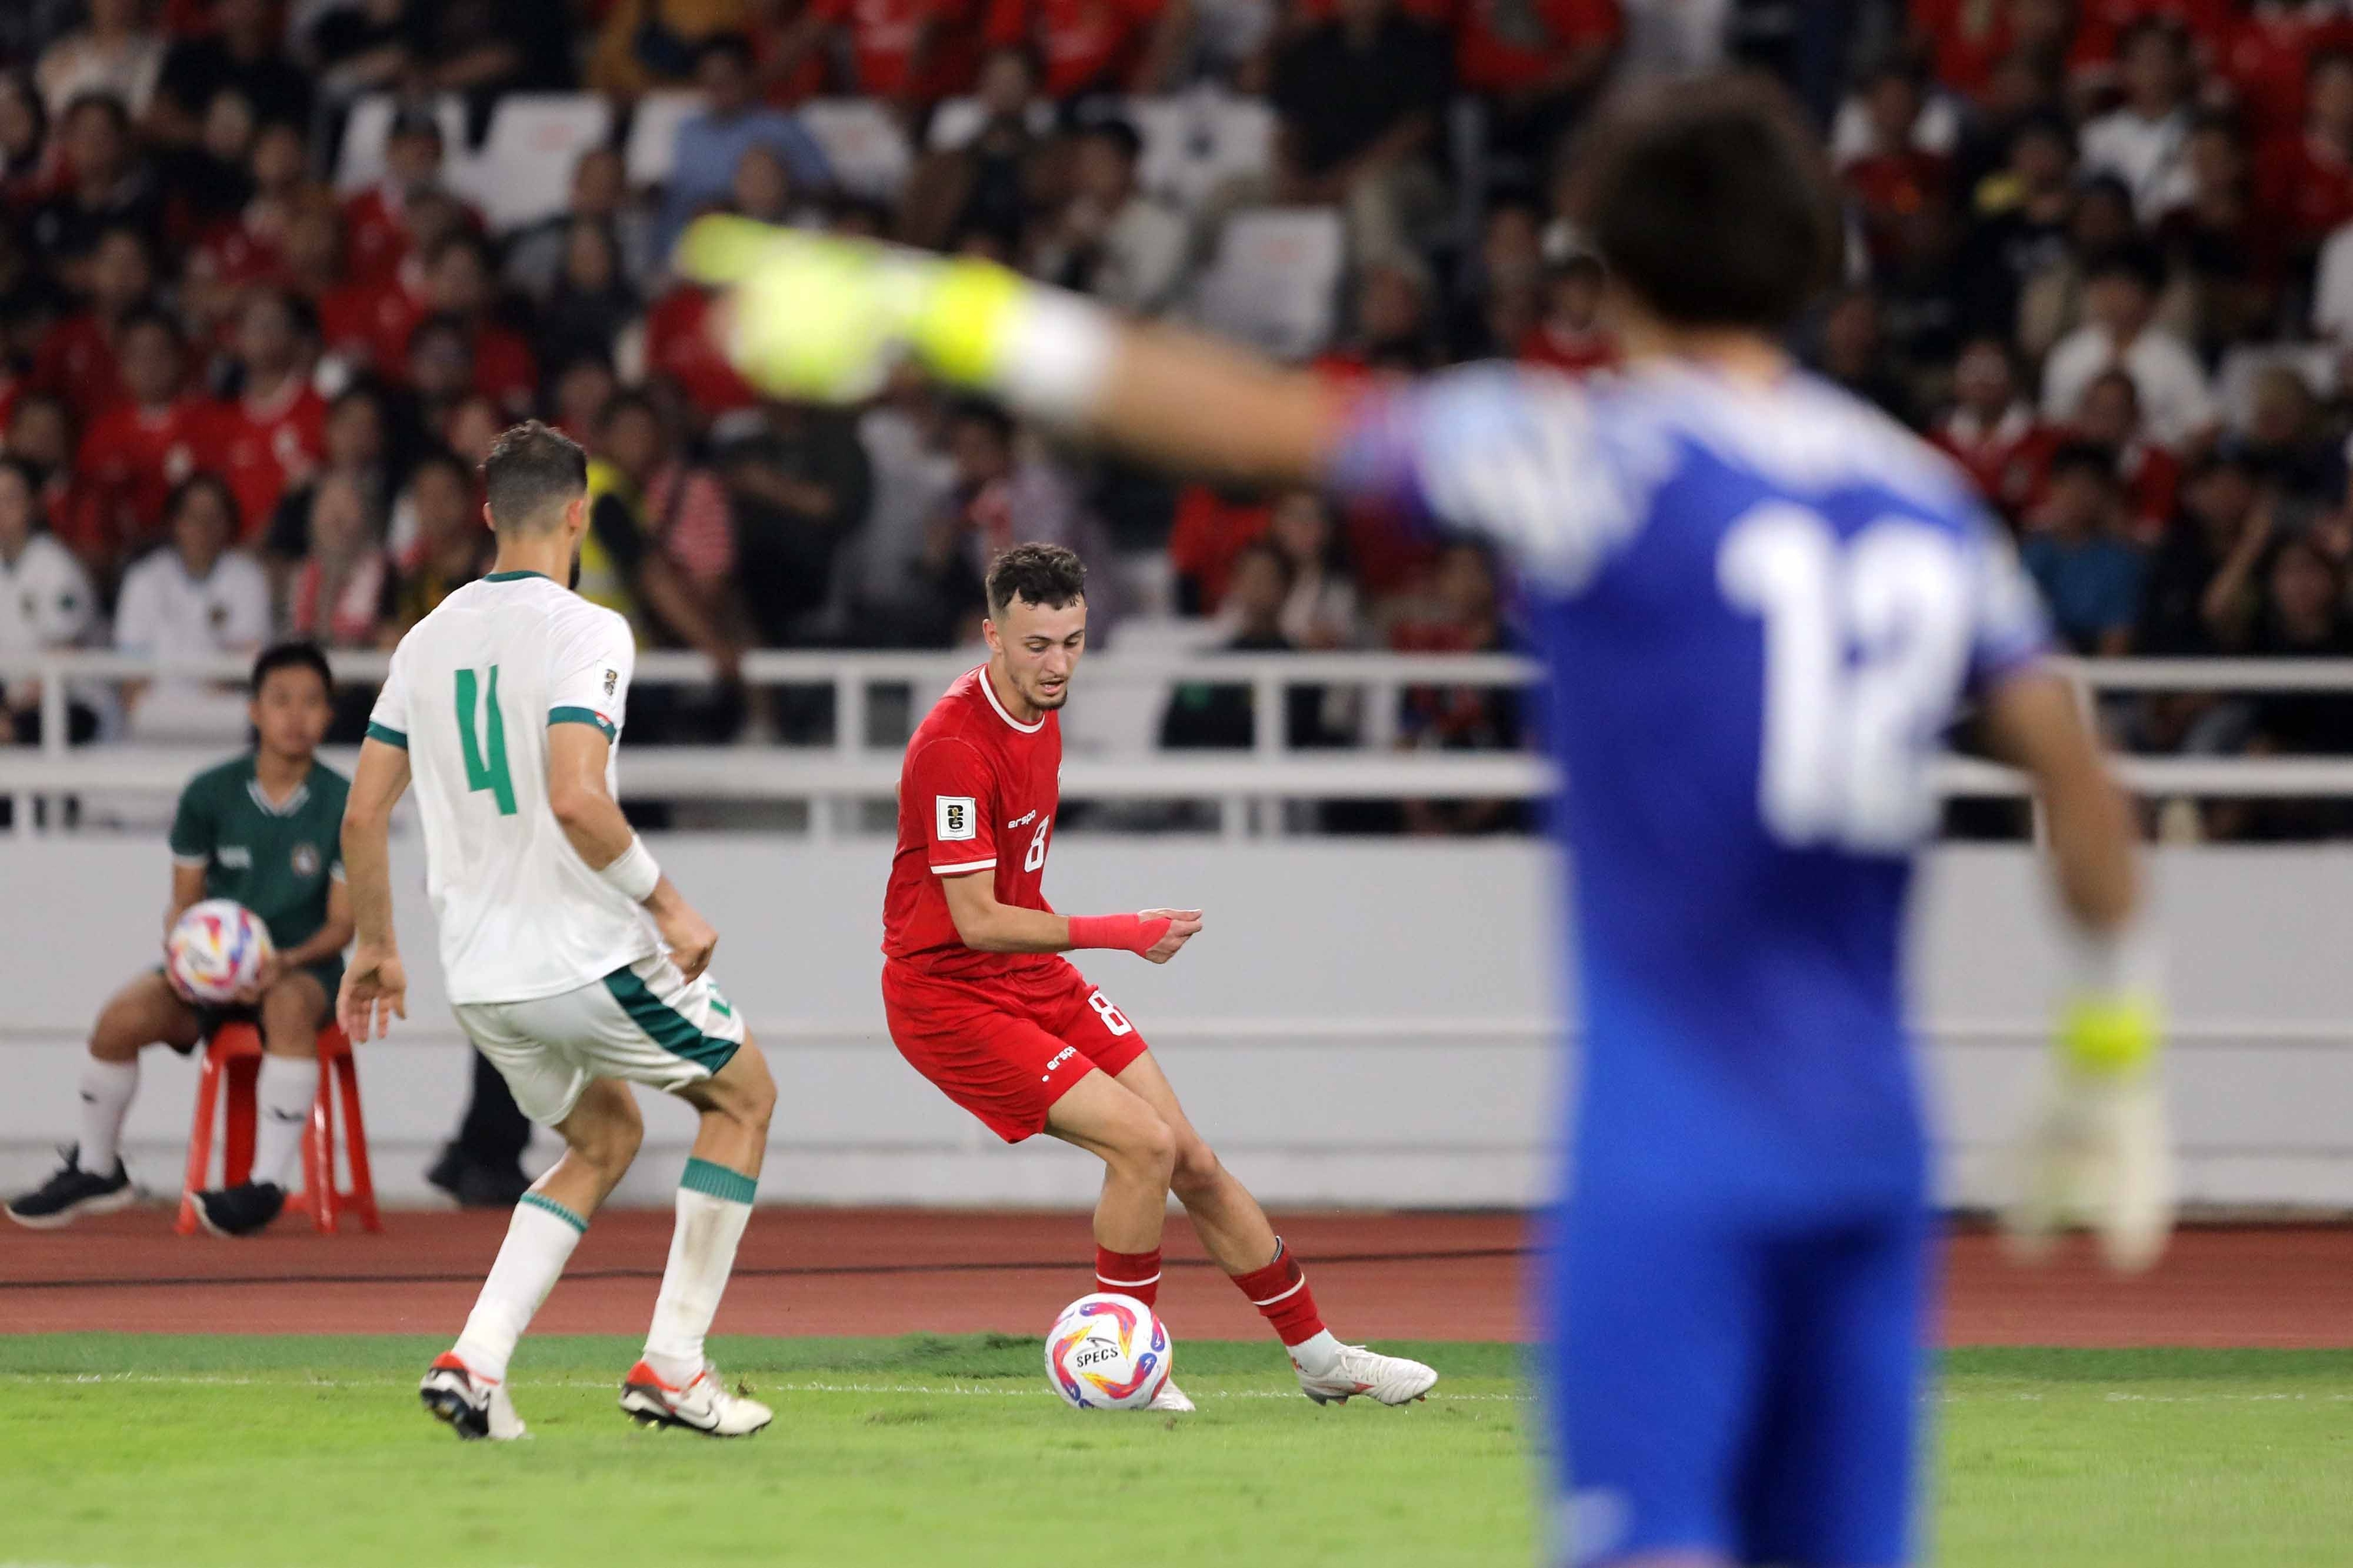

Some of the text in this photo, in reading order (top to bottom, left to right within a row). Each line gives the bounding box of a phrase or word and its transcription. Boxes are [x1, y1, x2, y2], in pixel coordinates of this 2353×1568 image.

[1718, 501, 1966, 852] 12
[455, 664, 518, 816] 4
[1008, 809, 1036, 828] erspo
[1025, 815, 1049, 873] 8
[1088, 990, 1132, 1036] 8
[1077, 1347, 1118, 1368] SPECS
